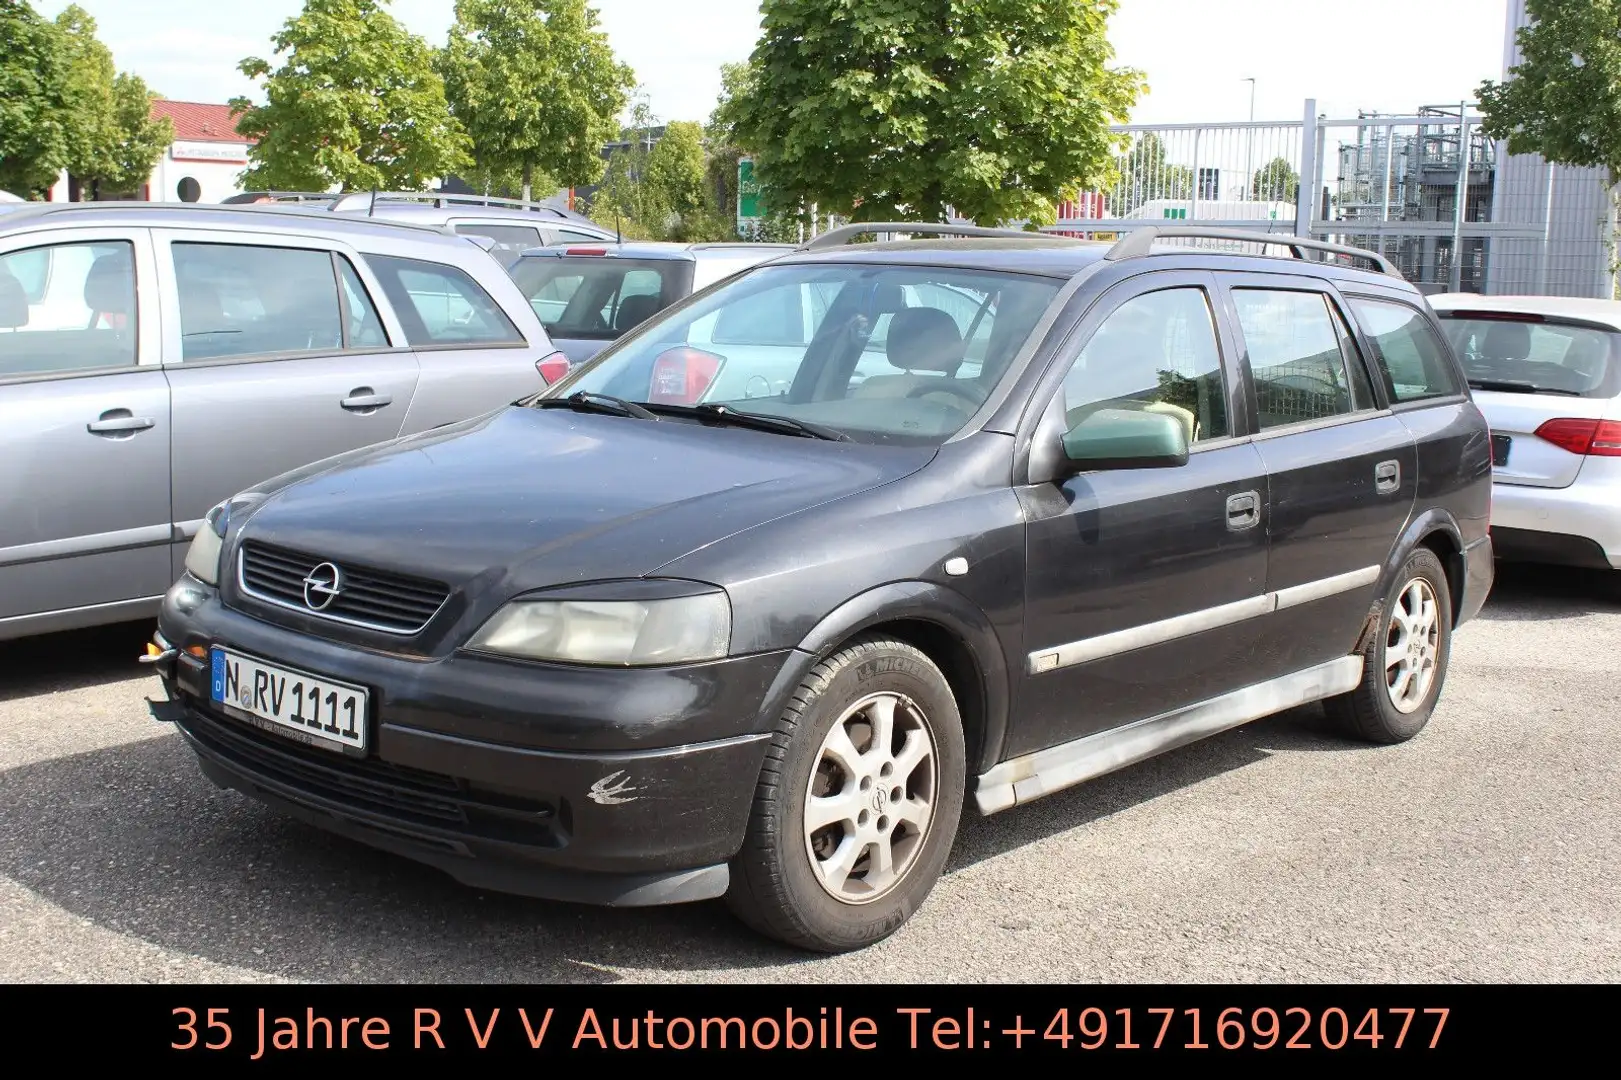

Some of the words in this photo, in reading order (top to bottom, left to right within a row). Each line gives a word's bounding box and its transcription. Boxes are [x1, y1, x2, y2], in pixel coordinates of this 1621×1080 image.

[215, 680, 222, 692] D
[225, 659, 239, 701] N
[254, 669, 286, 717] RV
[290, 682, 359, 741] 1111
